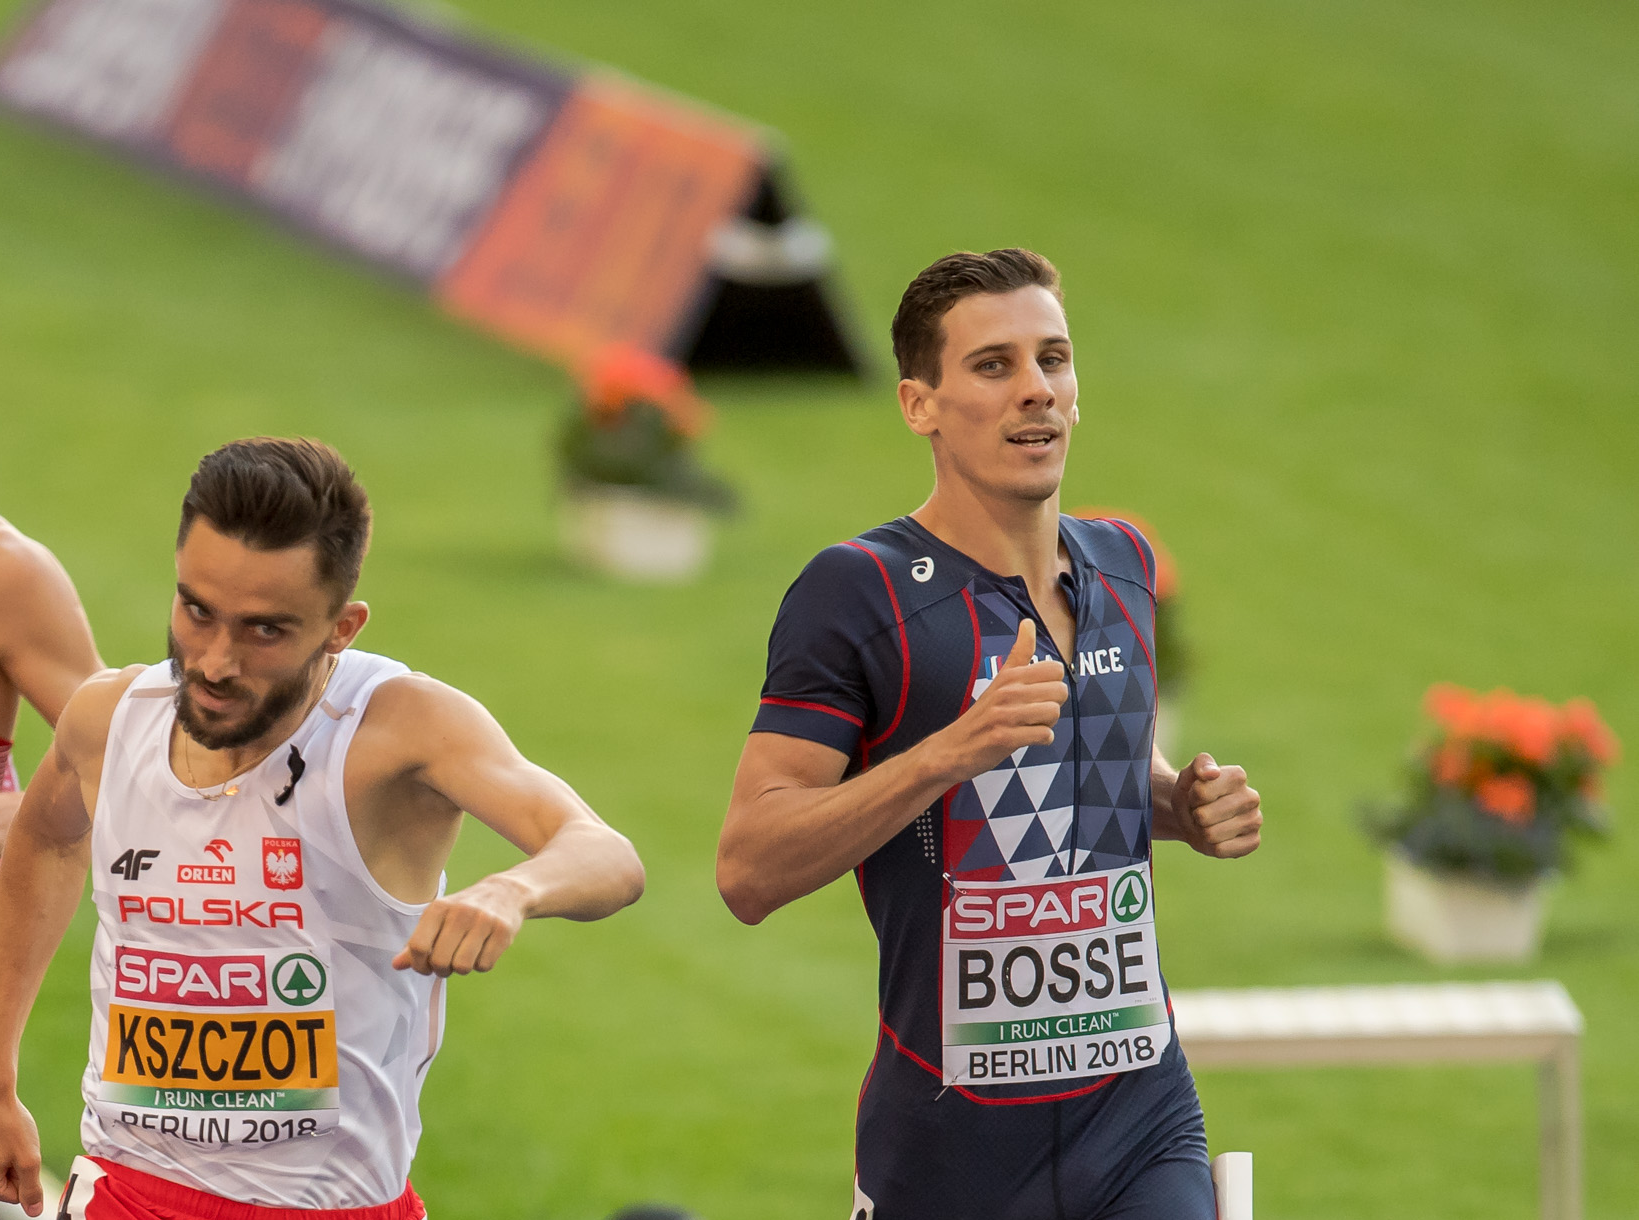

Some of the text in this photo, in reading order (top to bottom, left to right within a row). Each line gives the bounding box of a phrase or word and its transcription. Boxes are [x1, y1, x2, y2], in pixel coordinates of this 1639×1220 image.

[264, 838, 298, 849] POLSKA
[110, 848, 234, 883] 4F ORLEN
[118, 895, 304, 930] POLSKA
[954, 884, 1105, 932] SPAR
[119, 954, 263, 1000] SPAR
[958, 931, 1149, 1010] BOSSE
[116, 1012, 325, 1082] KSZCZOT
[999, 1024, 1005, 1041] I
[1011, 1022, 1050, 1039] RUN
[969, 1035, 1155, 1079] BERLIN 2018
[154, 1089, 161, 1106] I
[165, 1090, 204, 1107] RUN
[241, 1117, 317, 1144] 2018
